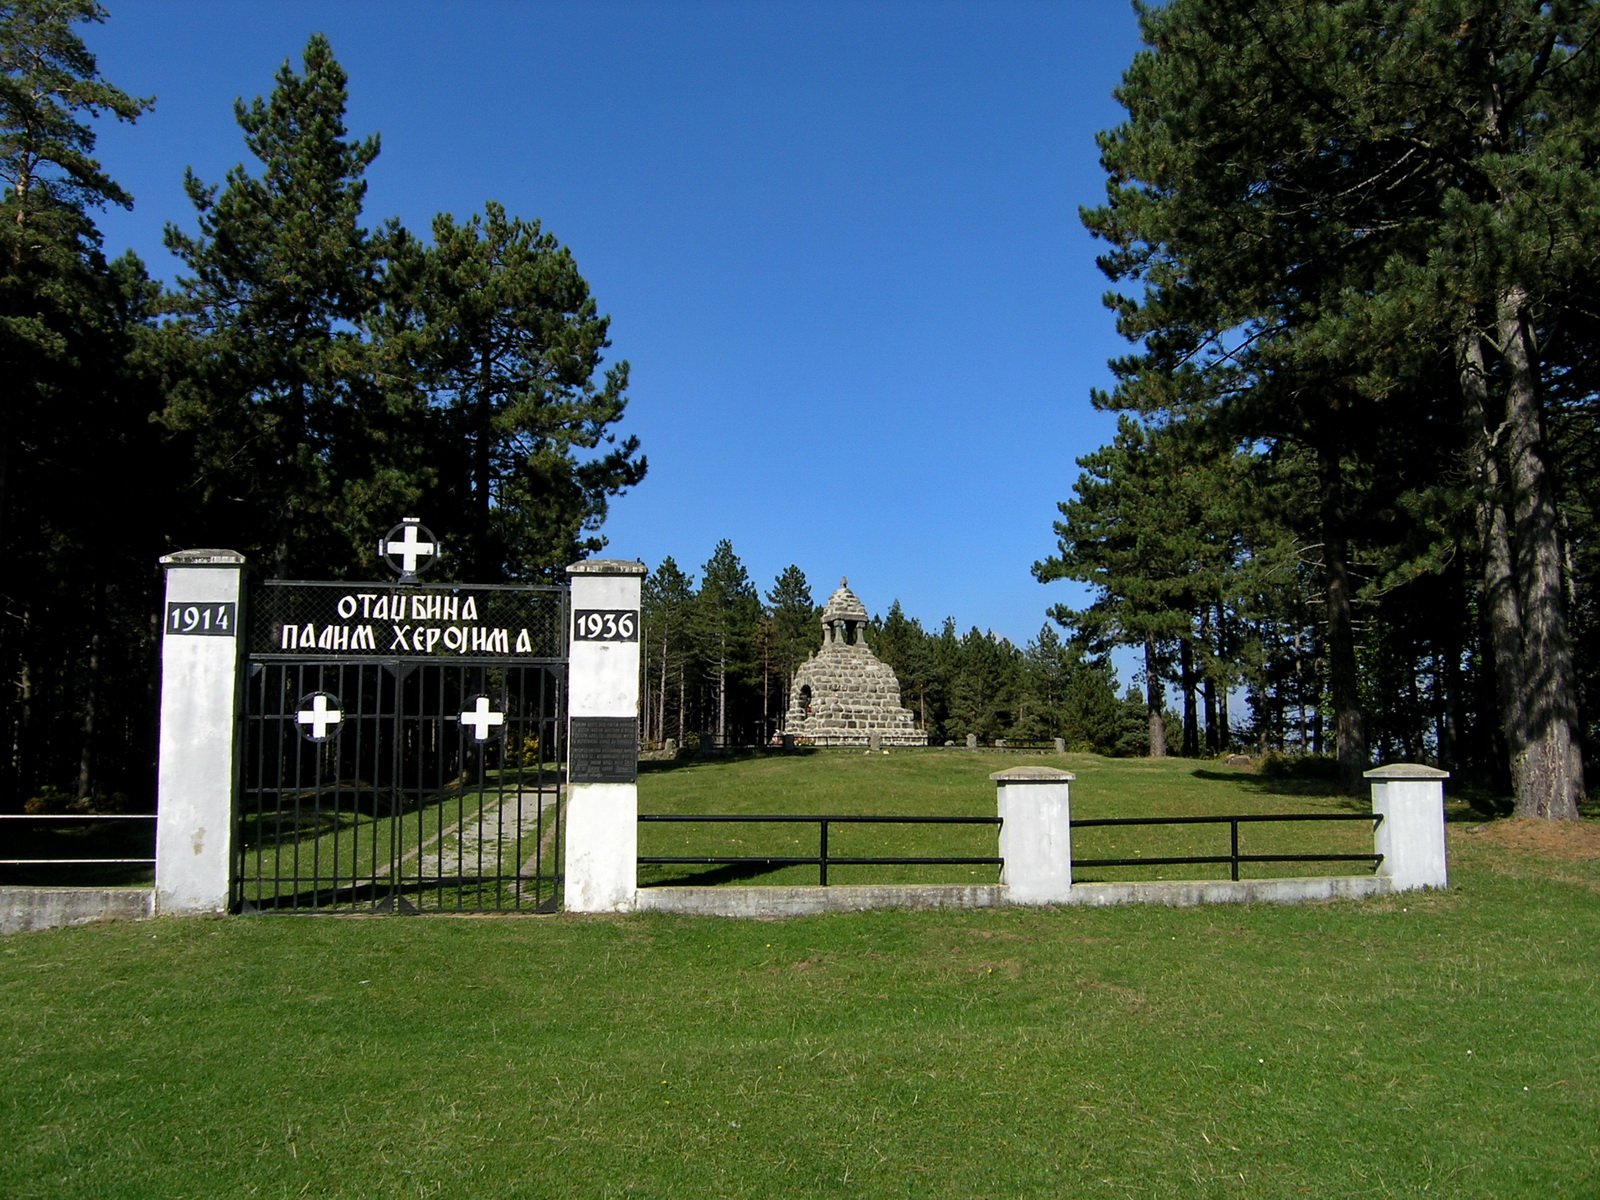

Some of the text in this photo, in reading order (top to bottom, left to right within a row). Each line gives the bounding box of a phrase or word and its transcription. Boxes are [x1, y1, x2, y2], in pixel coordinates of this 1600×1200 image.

[171, 605, 228, 632] 1914
[338, 594, 478, 624] ОТАЏБИНА
[282, 622, 533, 655] ПАЛИМ ХЕРОЈИМА
[577, 612, 634, 639] 1936
